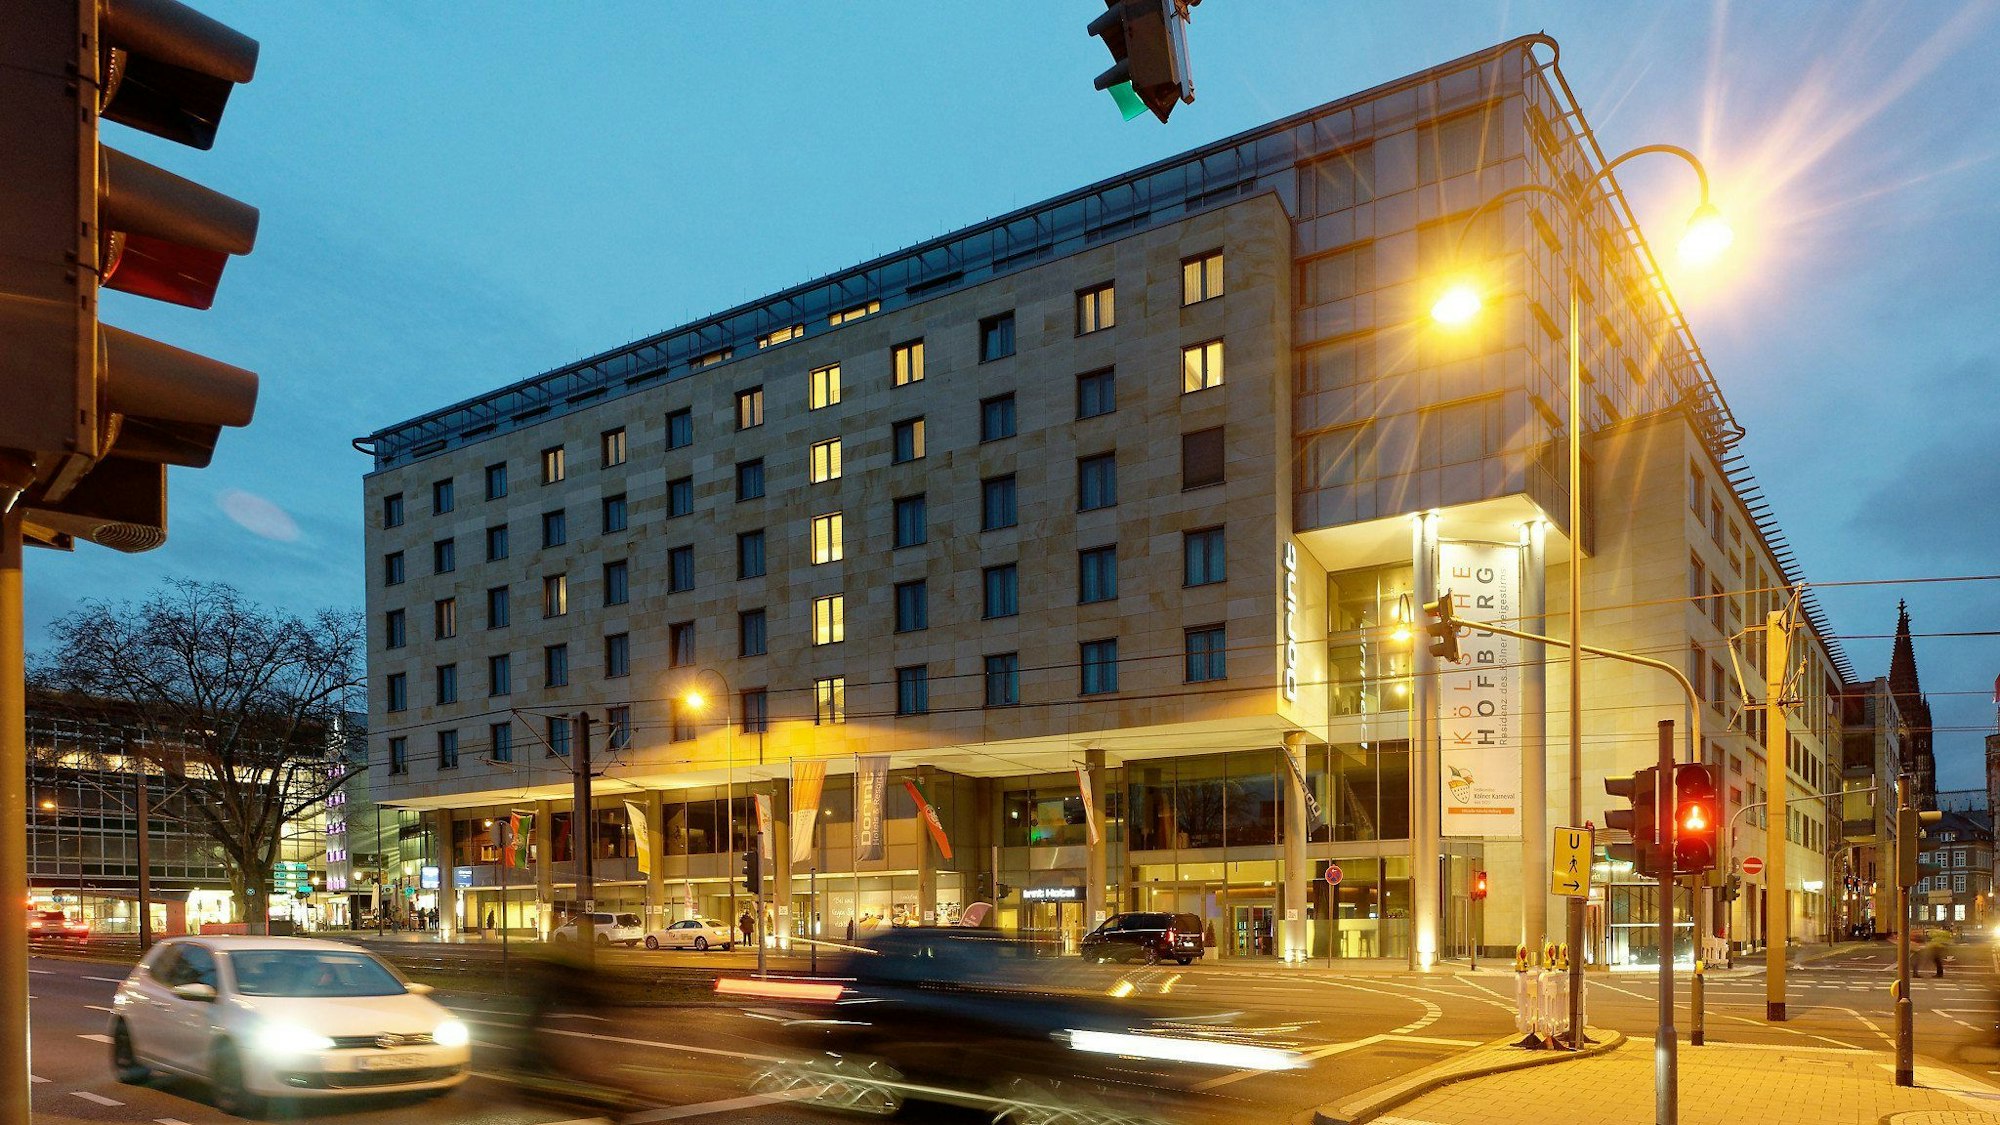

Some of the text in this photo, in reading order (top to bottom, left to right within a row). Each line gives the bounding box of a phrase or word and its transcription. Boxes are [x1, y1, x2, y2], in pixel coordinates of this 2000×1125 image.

[1282, 542, 1297, 704] Dorint
[1499, 676, 1508, 694] des
[1499, 699, 1508, 745] Residenz
[873, 770, 884, 806] Resorts
[1492, 792, 1516, 800] Karneval
[860, 772, 875, 846] Dorint
[872, 815, 880, 846] Hotels
[1569, 834, 1580, 850] U
[1045, 888, 1075, 898] Hotel
[586, 902, 593, 913] 5
